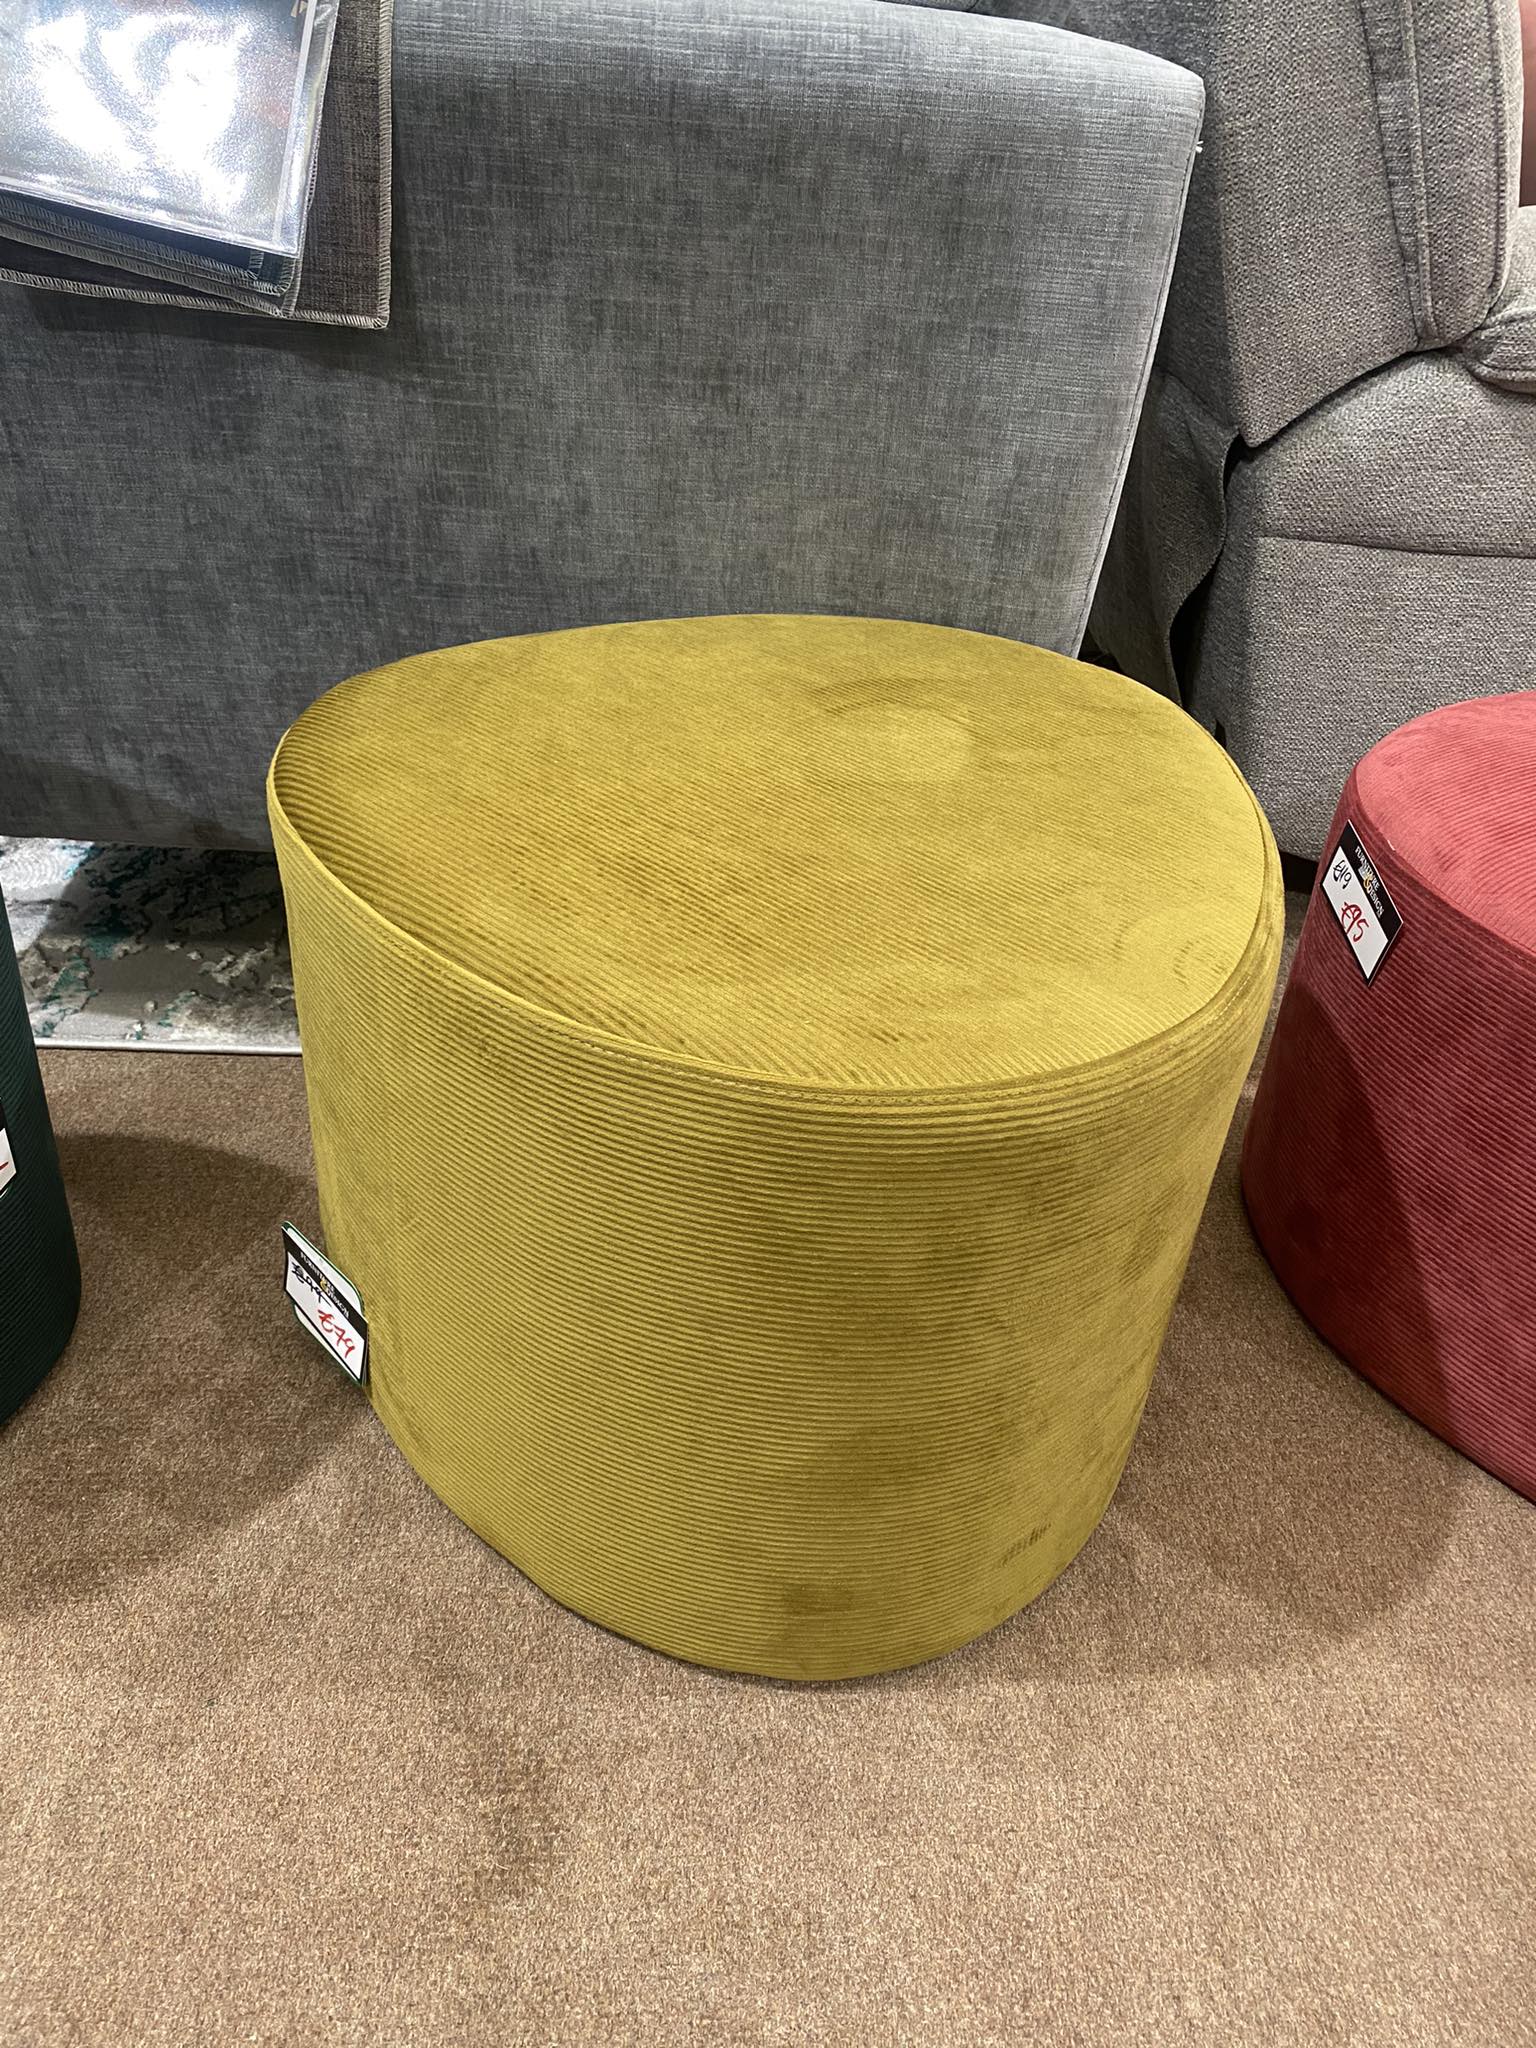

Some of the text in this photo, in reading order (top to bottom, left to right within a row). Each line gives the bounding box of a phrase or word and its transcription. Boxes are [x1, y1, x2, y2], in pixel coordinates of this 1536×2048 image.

[1354, 846, 1380, 891] FURNITURE
[1367, 884, 1385, 914] DESIGN
[1340, 901, 1370, 943] £95
[317, 1308, 356, 1359] £79
